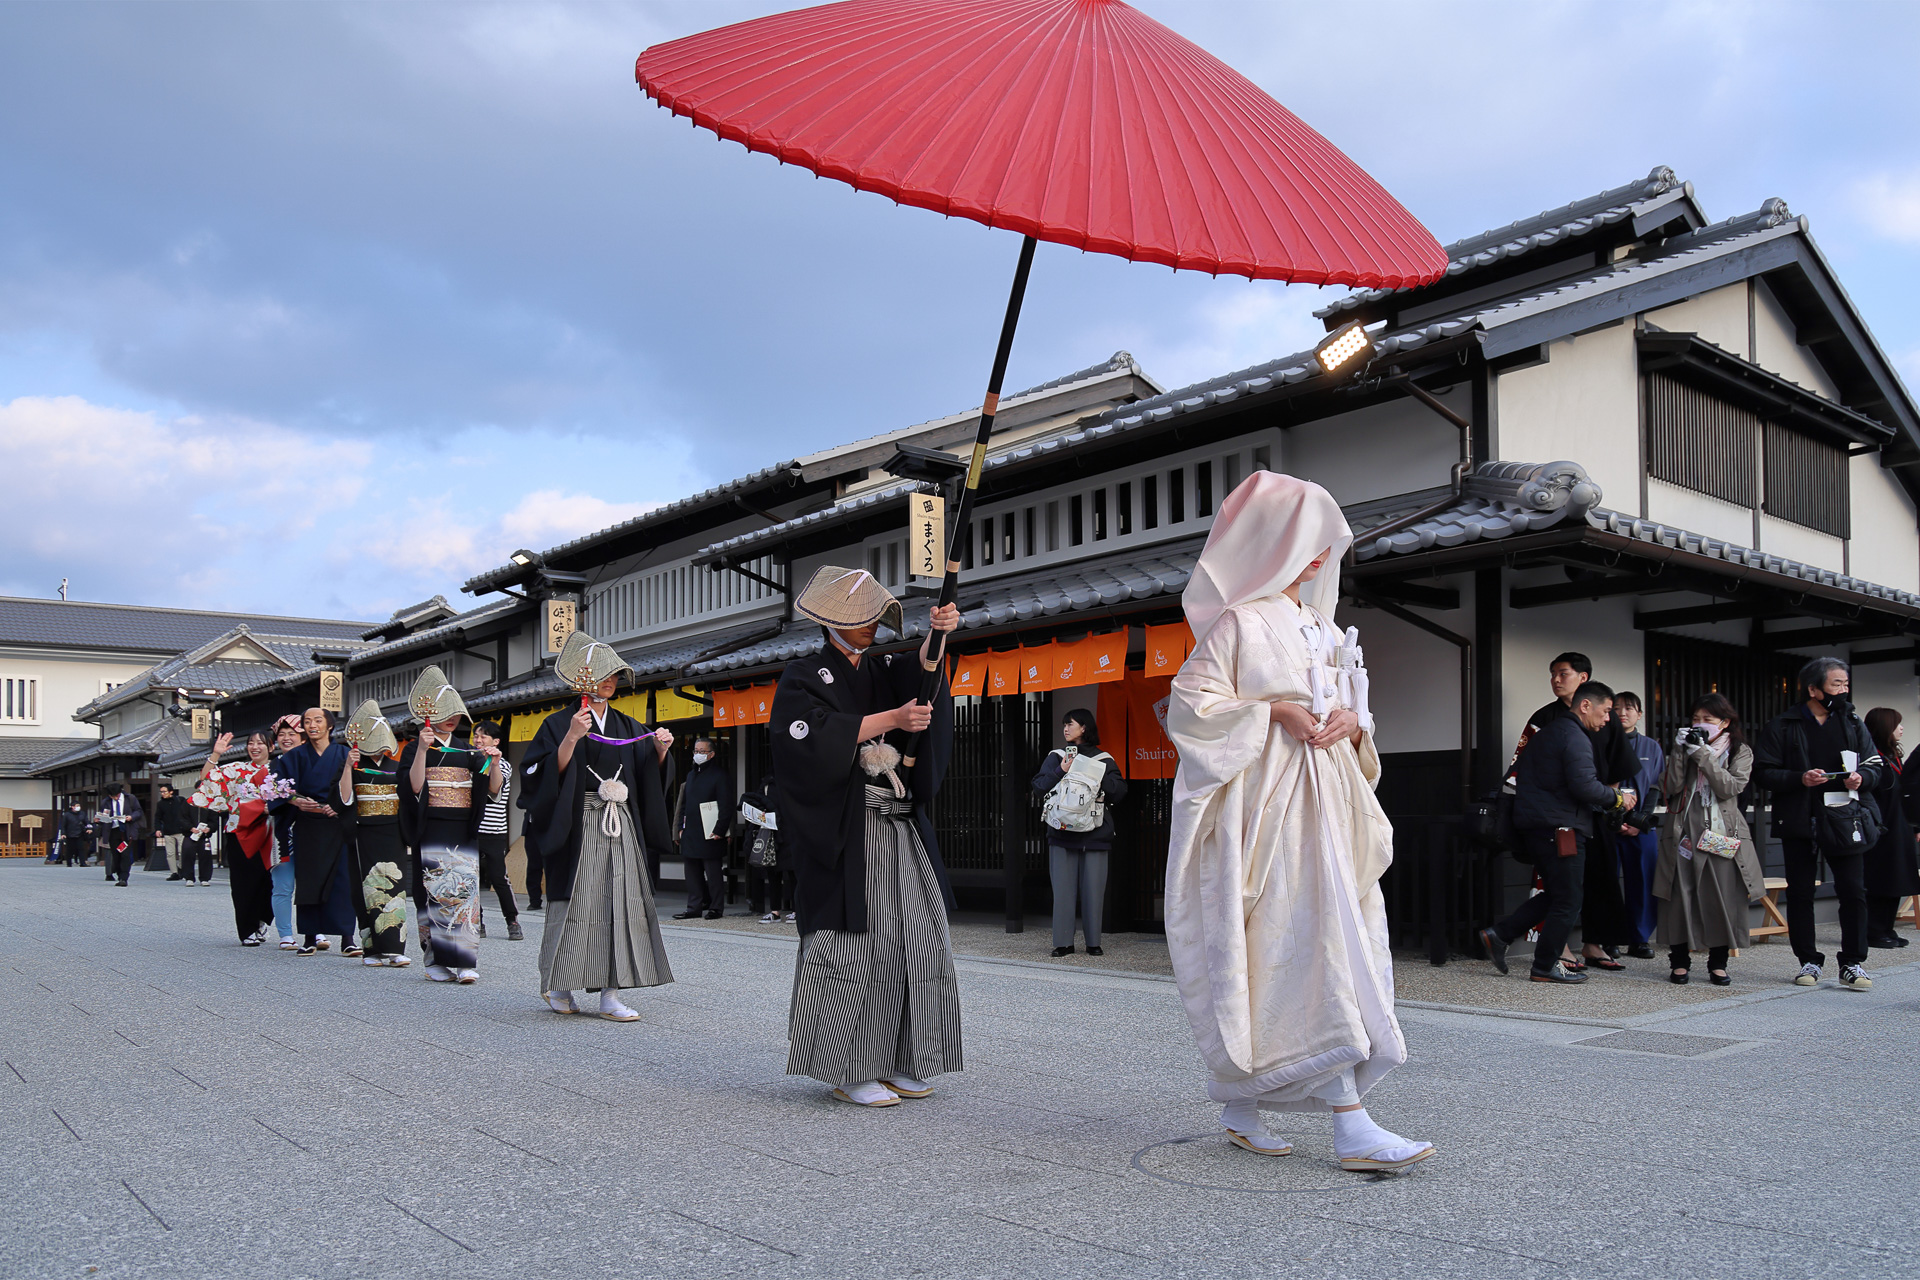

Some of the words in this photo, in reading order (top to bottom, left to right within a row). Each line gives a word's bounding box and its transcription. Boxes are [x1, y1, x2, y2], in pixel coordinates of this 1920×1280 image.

[924, 521, 935, 572] まぐろ
[1135, 747, 1175, 761] Shuiro
